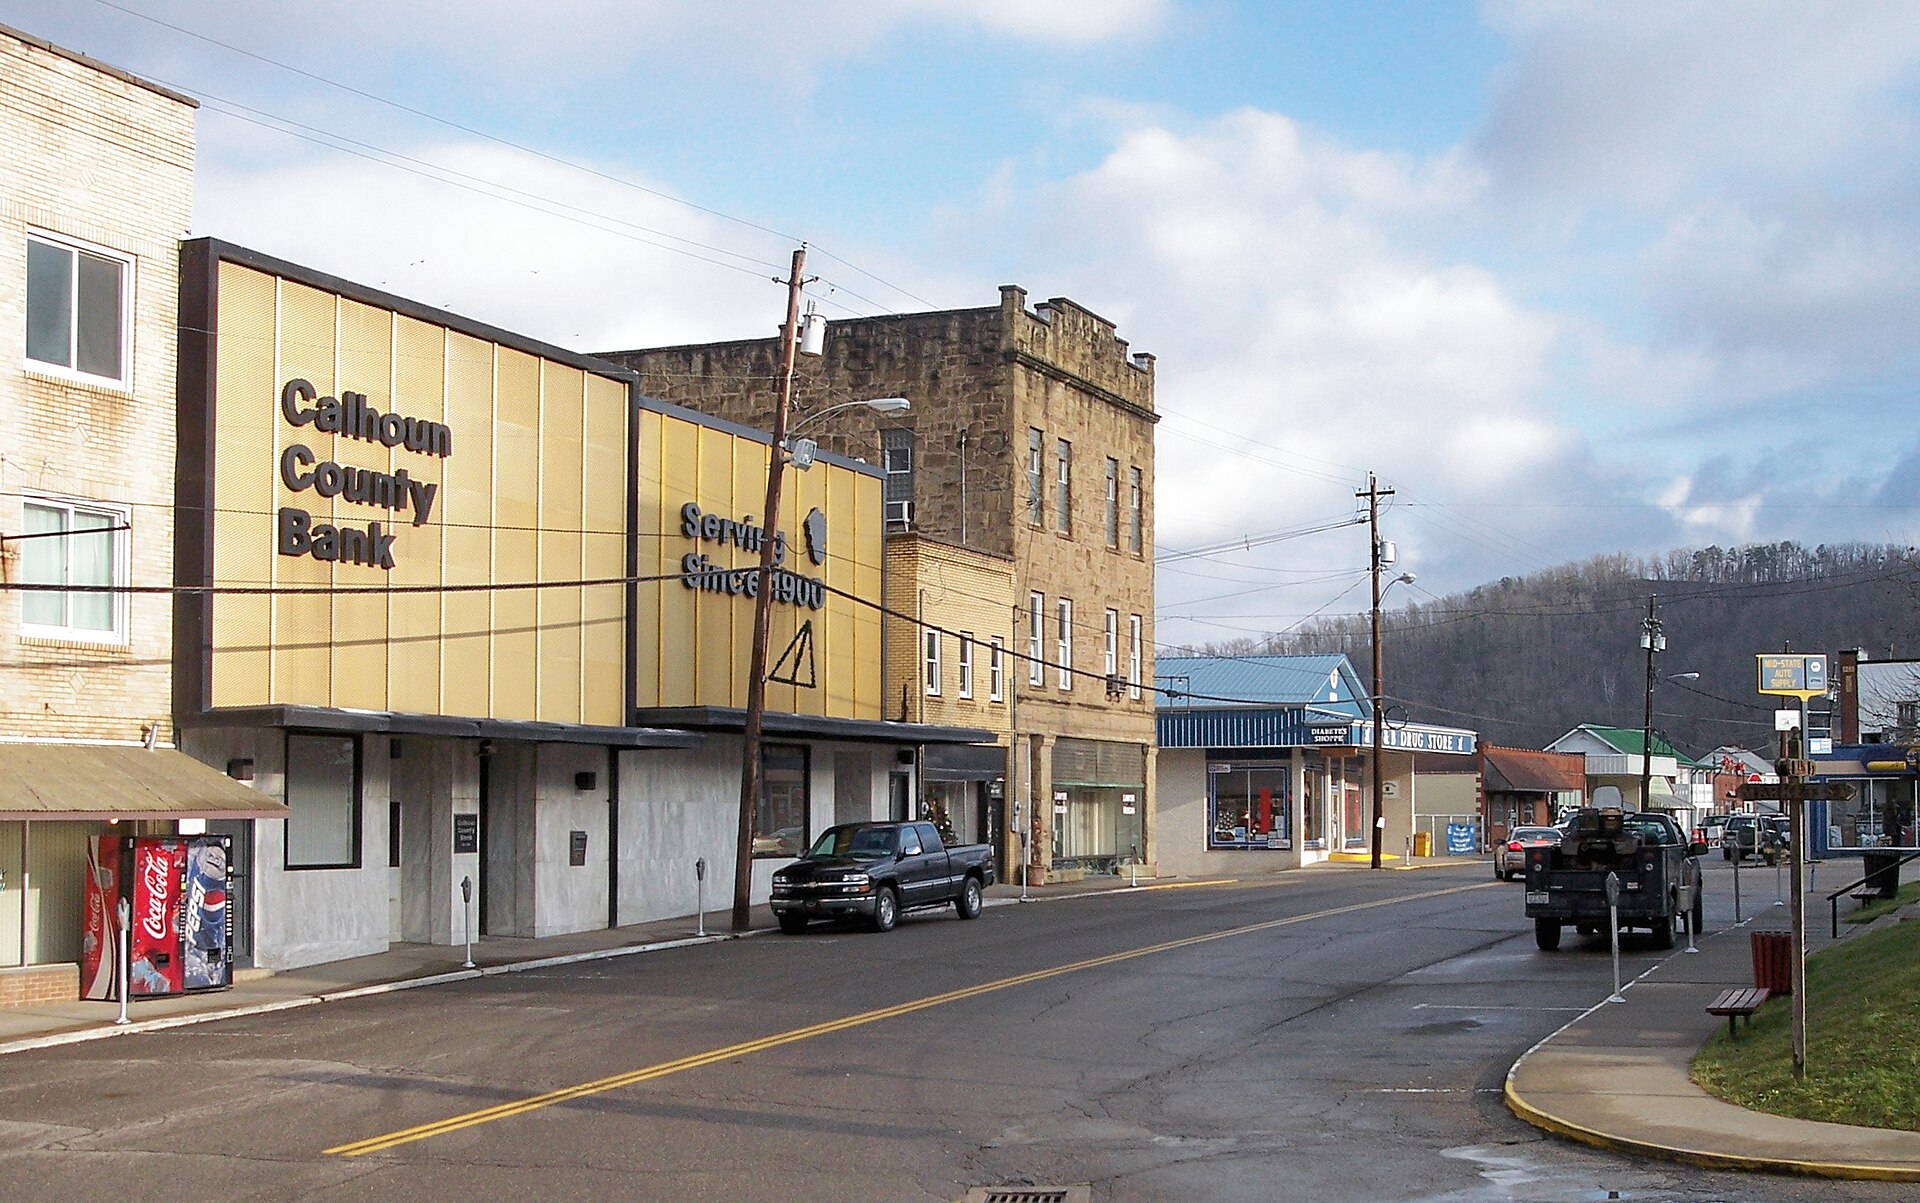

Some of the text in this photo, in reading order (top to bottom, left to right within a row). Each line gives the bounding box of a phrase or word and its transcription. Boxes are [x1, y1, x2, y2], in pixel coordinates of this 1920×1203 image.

[281, 378, 453, 458] Calhoun
[280, 444, 438, 527] County
[278, 507, 396, 570] Bank
[682, 553, 826, 611] Since 1900
[1765, 659, 1801, 668] MID-STATE
[1771, 679, 1796, 687] SUPPLY
[1774, 669, 1792, 677] AUTO
[1400, 732, 1424, 749] DRUG
[1427, 734, 1453, 751] STORE
[184, 876, 206, 946] PEPSI
